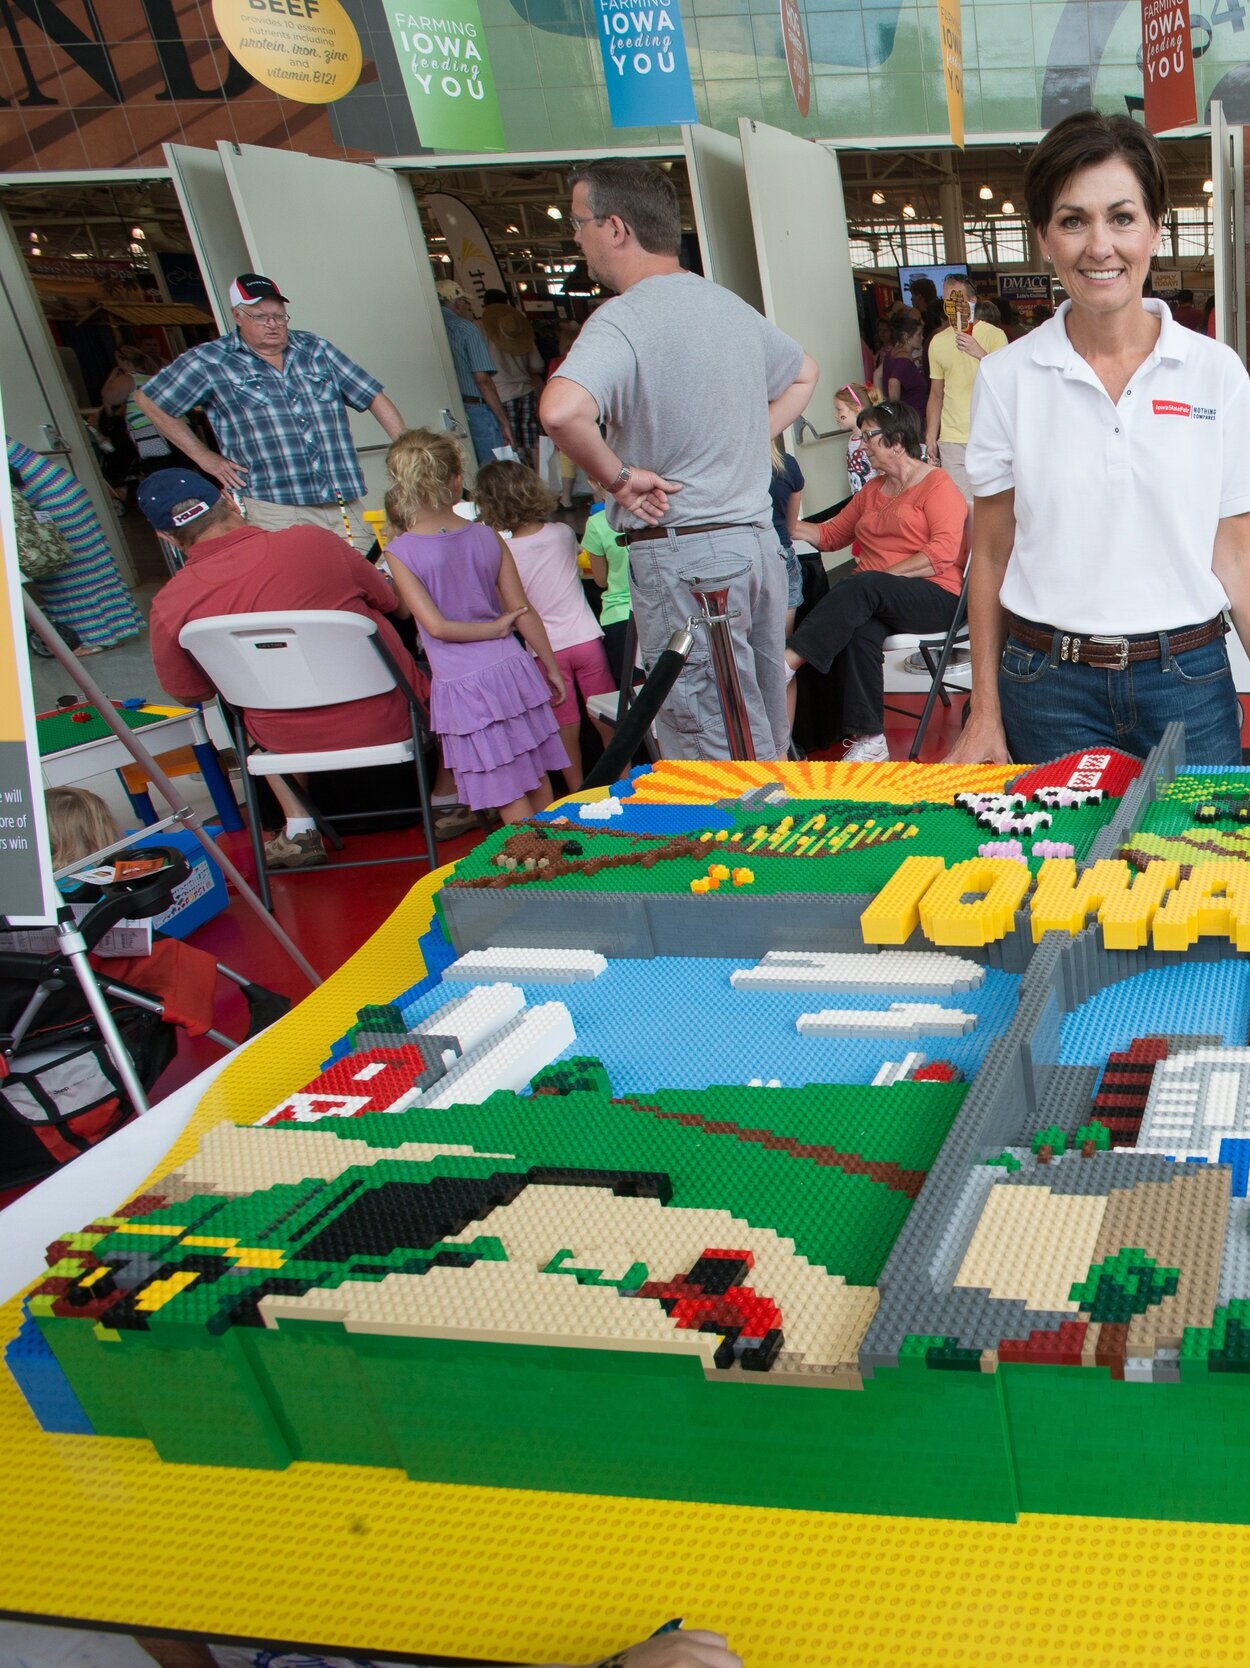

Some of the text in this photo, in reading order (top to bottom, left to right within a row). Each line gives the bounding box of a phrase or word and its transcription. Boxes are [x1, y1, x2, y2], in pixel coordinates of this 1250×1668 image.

[249, 0, 321, 18] BEEF
[240, 14, 337, 36] provides 10 essential
[394, 12, 477, 38] FARMING
[603, 9, 675, 35] IOWA
[1145, 8, 1185, 44] IOWA
[248, 26, 335, 47] nutrients including
[400, 30, 482, 61] IOWA
[609, 33, 672, 56] feeding
[324, 49, 349, 64] zinc
[1147, 34, 1183, 63] feeding
[289, 58, 310, 68] and
[411, 53, 480, 81] feeding
[611, 52, 675, 76] YOU
[1148, 51, 1184, 82] YOU
[266, 67, 337, 86] vitamin B12!
[414, 73, 485, 100] YOU
[1003, 276, 1048, 289] DMACC
[1193, 407, 1217, 415] NOTHING
[5, 789, 22, 803] will
[17, 814, 28, 829] of
[9, 836, 28, 850] win
